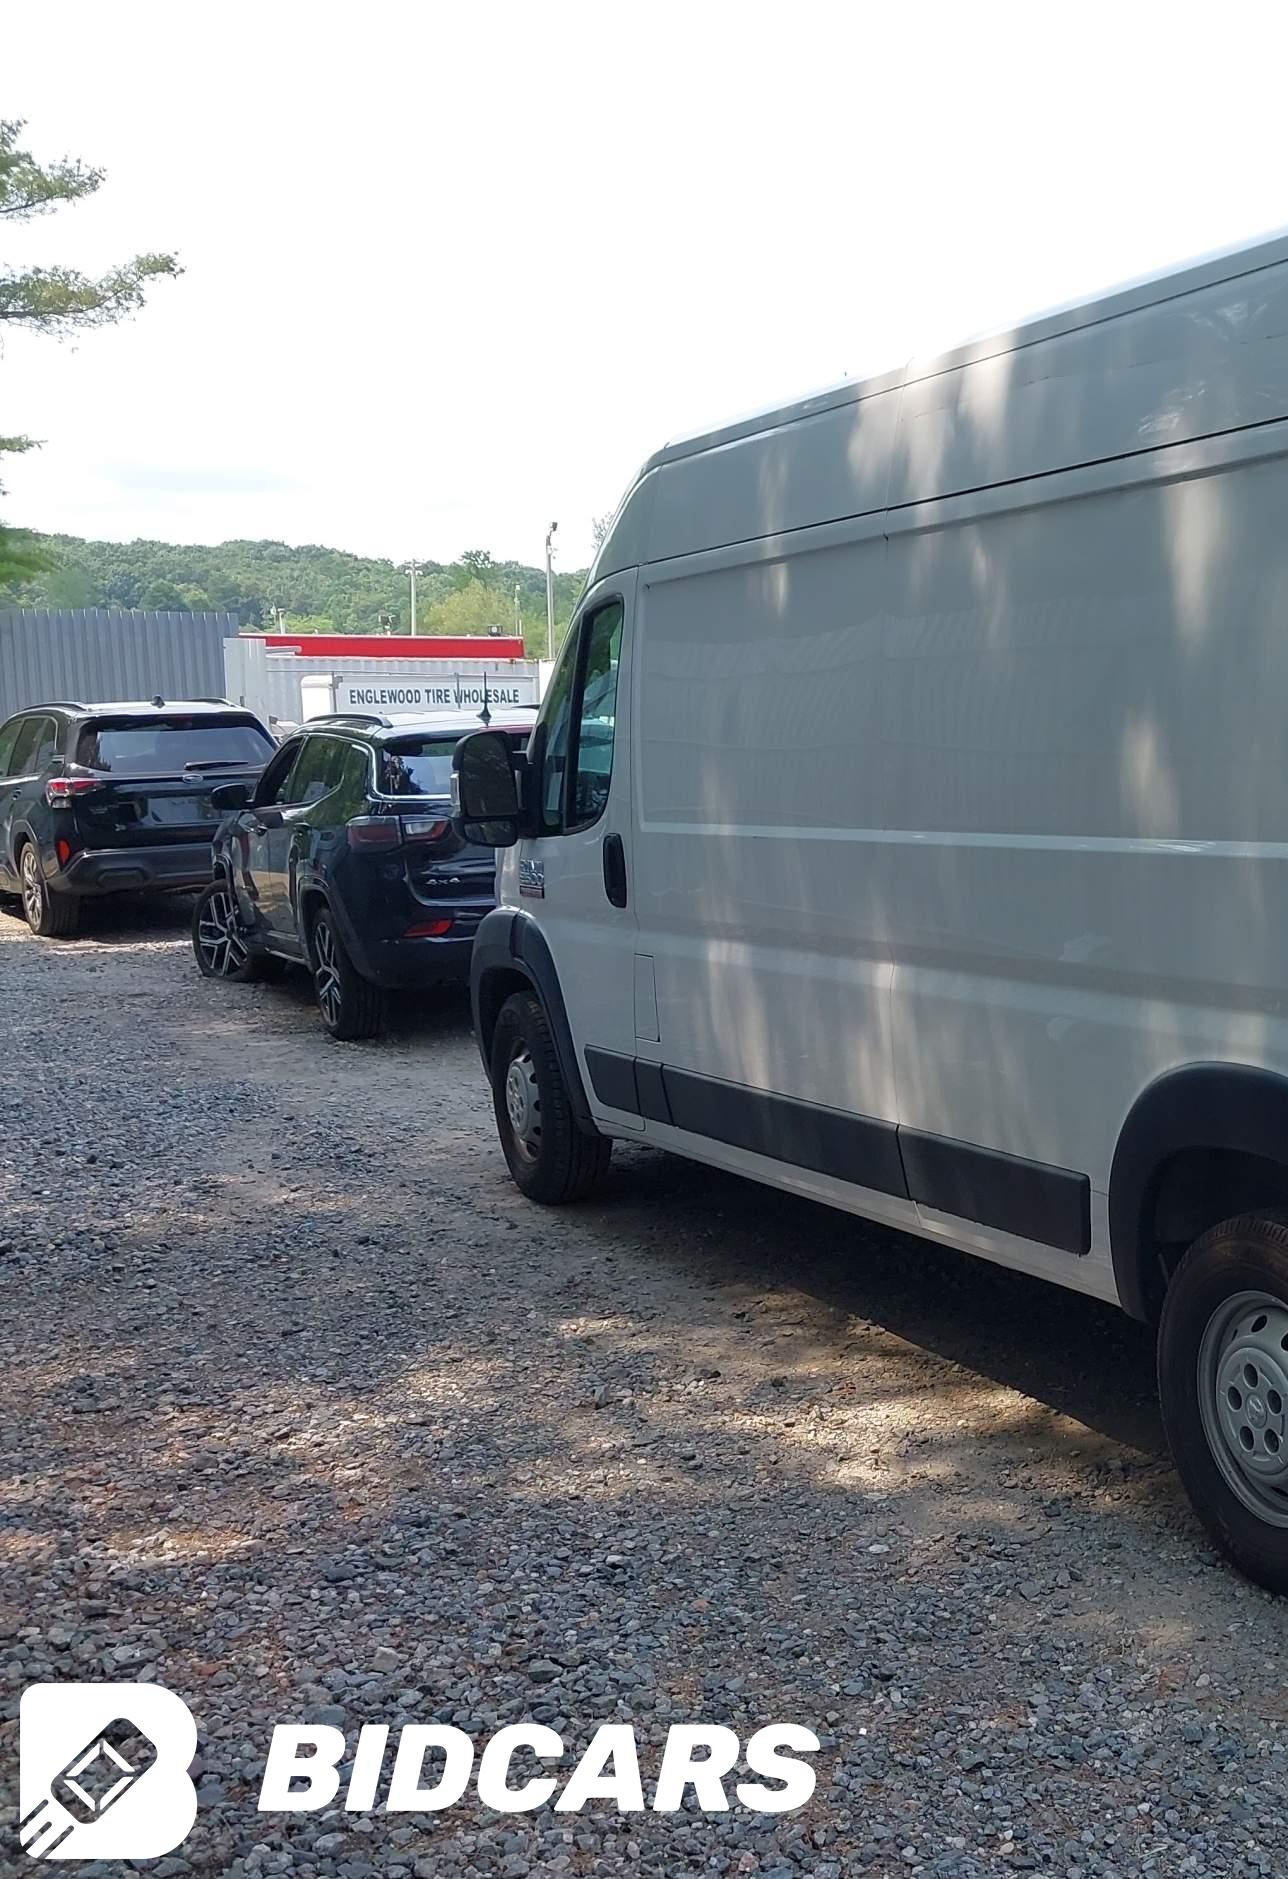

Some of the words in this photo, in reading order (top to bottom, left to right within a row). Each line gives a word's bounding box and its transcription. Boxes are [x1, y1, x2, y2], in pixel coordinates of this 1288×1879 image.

[349, 688, 421, 704] ENGLEWOOD
[425, 688, 451, 704] TIRE
[453, 688, 520, 704] WHOLESALE
